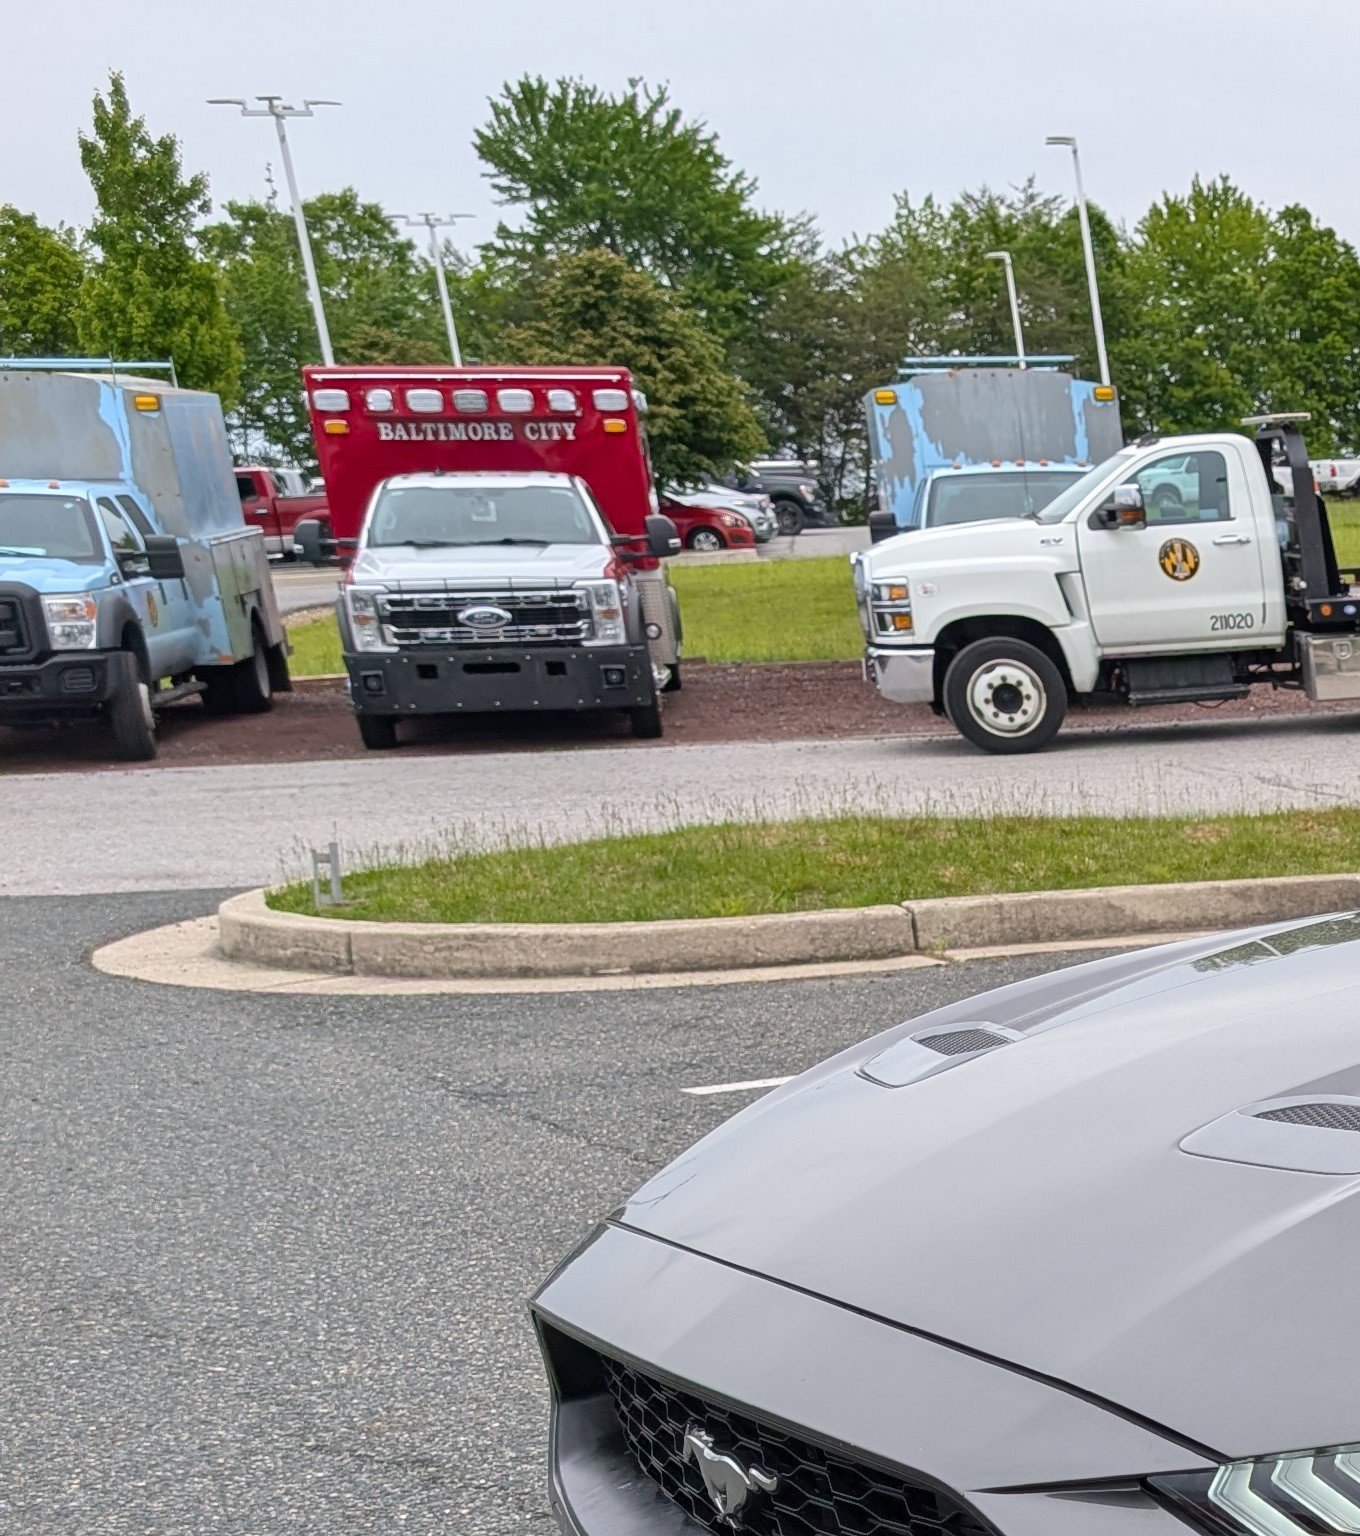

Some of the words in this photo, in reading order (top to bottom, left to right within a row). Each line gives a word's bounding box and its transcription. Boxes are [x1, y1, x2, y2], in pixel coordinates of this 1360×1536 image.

[377, 422, 514, 441] BALTIMORE
[524, 422, 576, 441] CITY
[1209, 613, 1255, 631] 211020
